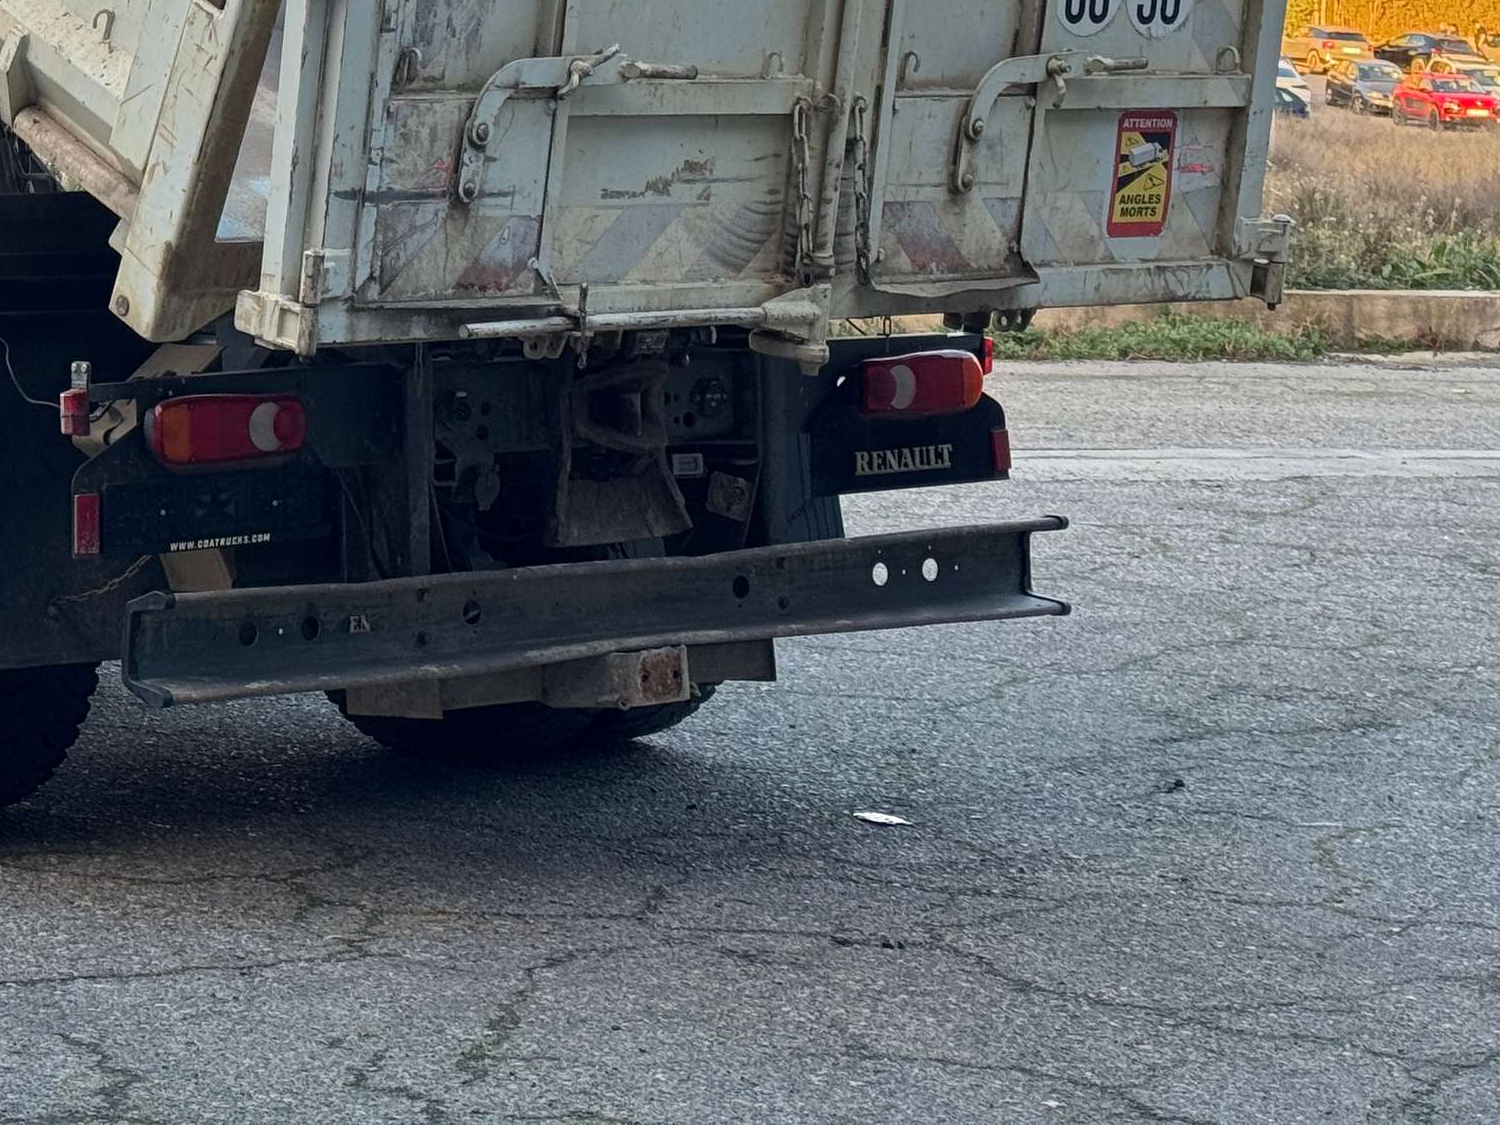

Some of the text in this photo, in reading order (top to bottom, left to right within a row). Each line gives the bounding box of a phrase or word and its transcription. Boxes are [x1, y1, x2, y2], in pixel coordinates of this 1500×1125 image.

[1123, 118, 1173, 128] ATTENTION
[1119, 194, 1162, 205] ANGLES
[1119, 207, 1157, 218] MORTS
[854, 444, 953, 475] RENAULT
